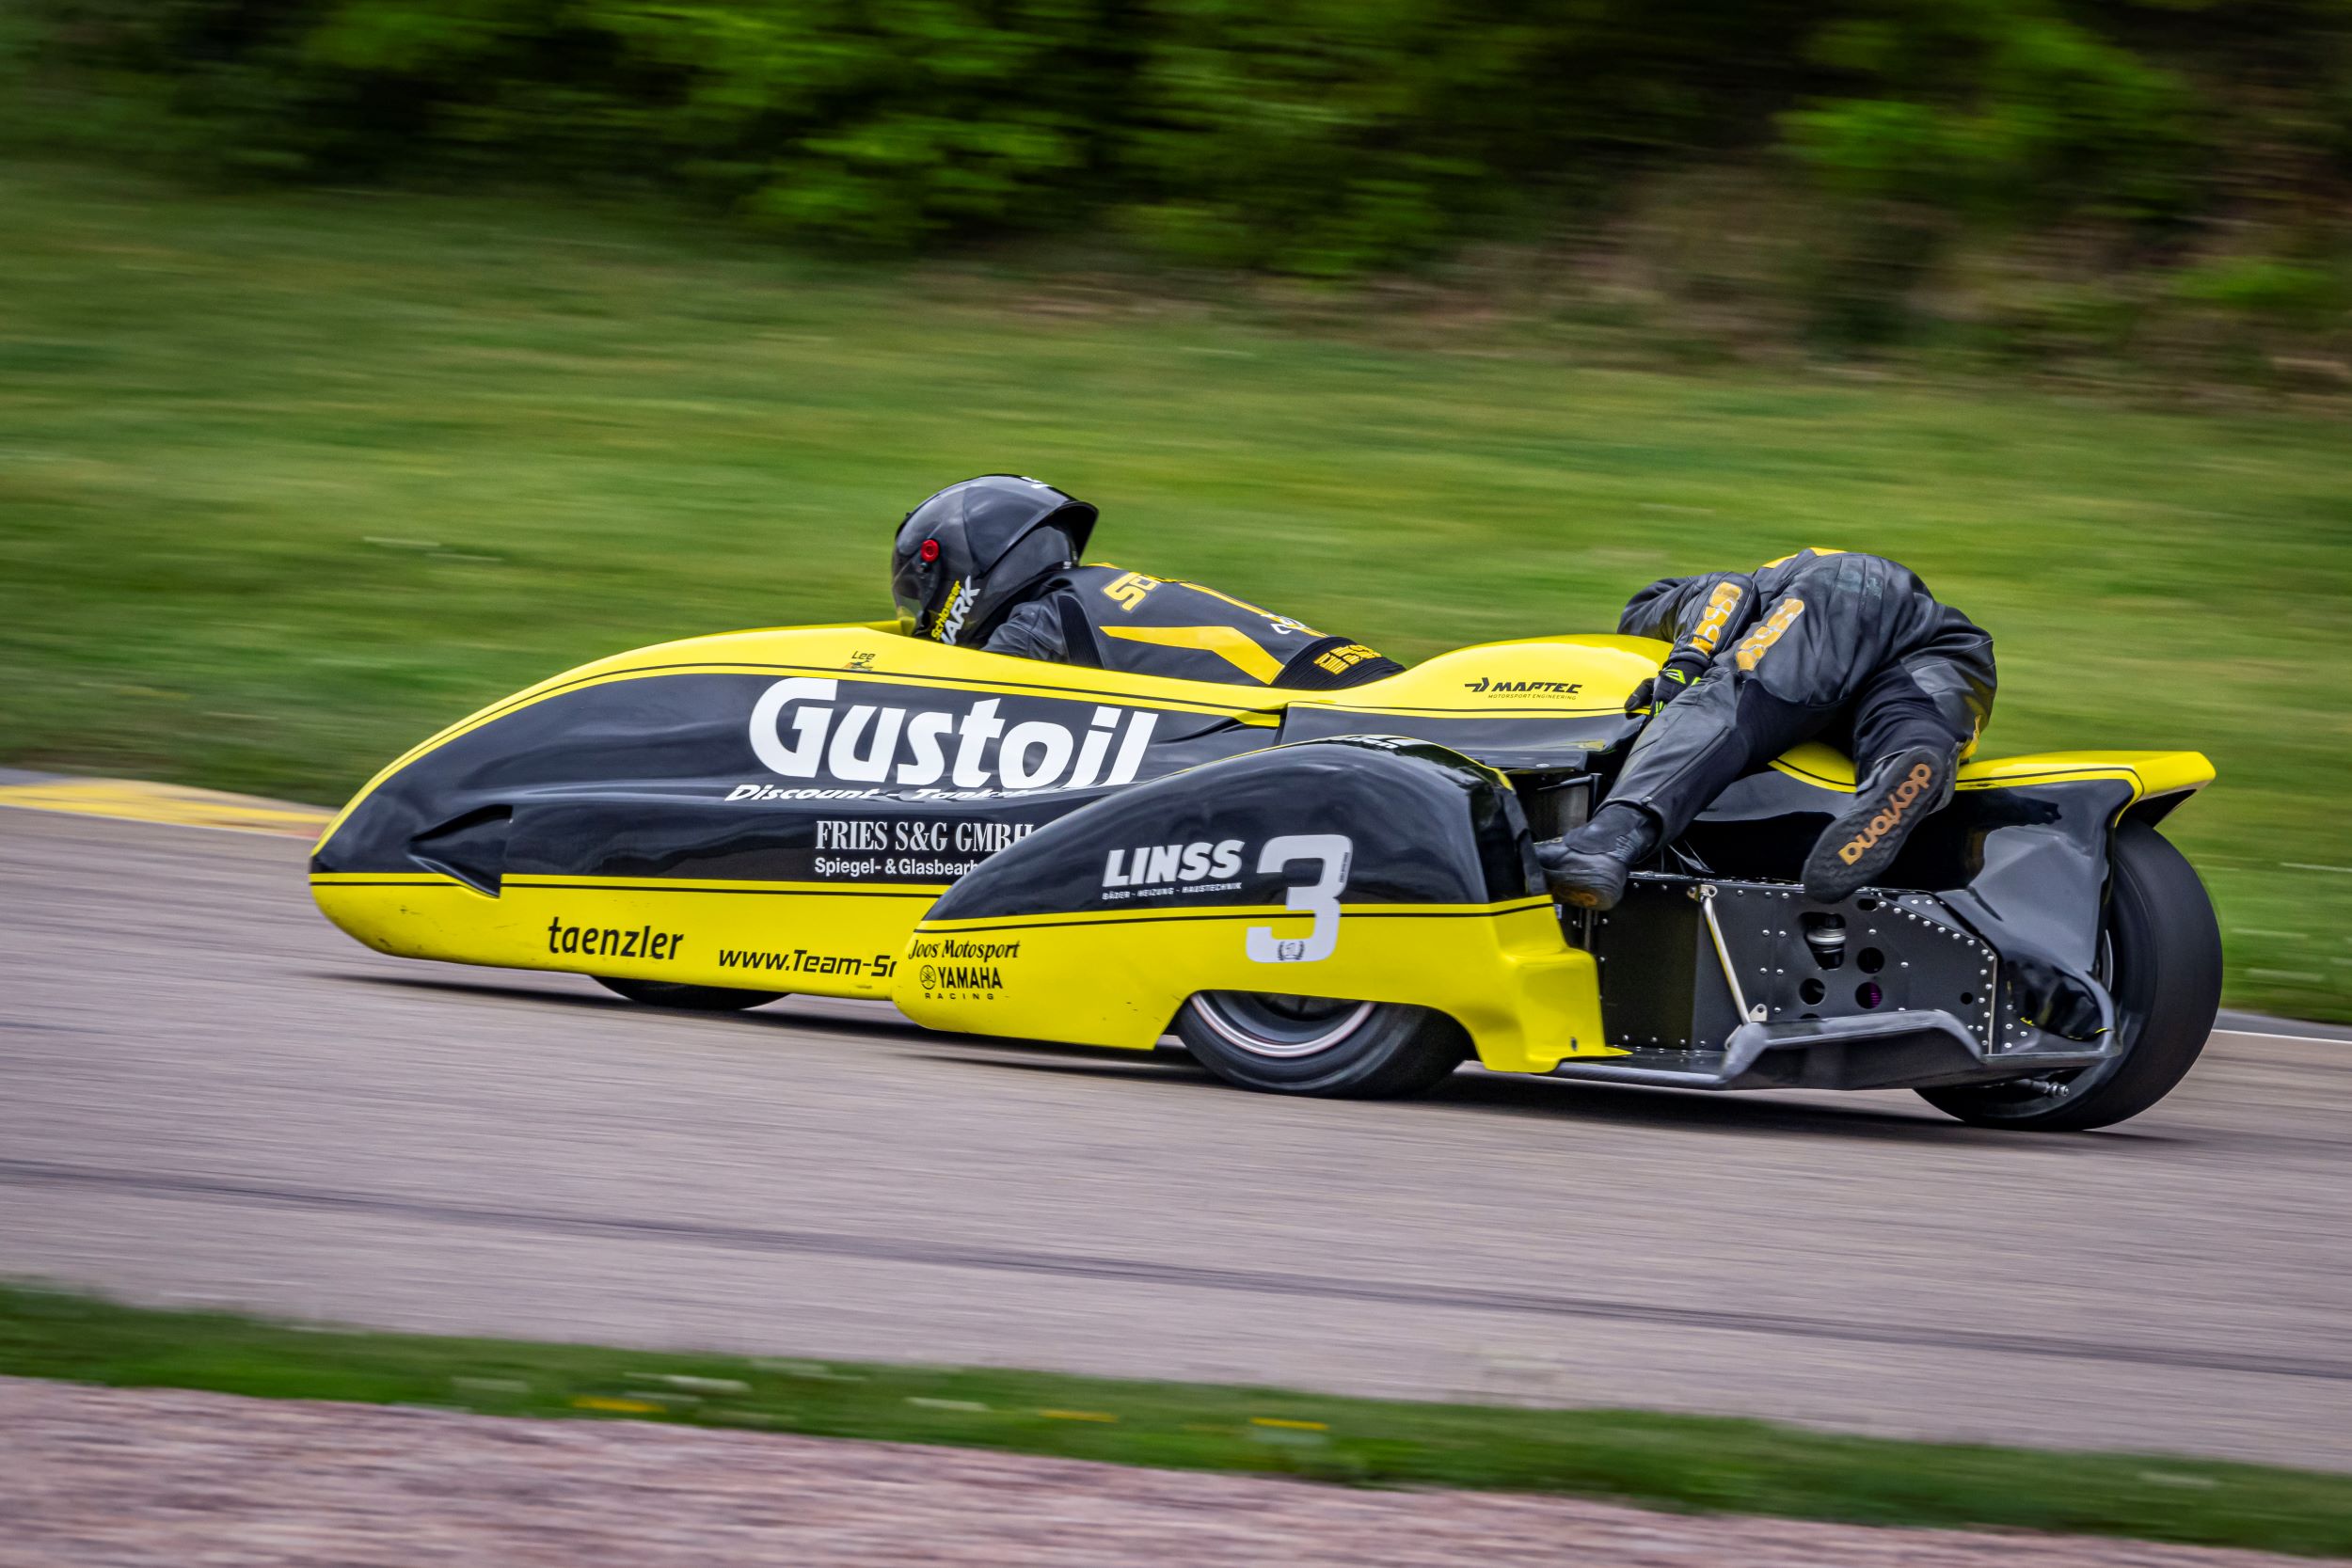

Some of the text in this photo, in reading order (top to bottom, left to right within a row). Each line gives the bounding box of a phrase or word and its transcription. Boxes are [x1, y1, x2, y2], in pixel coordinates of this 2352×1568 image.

[850, 650, 876, 660] Lee
[749, 676, 1158, 789] Gustoil
[724, 784, 881, 801] Discount
[1837, 763, 1931, 865] daytona
[815, 820, 888, 850] FRIES
[895, 821, 948, 851] S&G
[814, 857, 882, 877] Spiegel-
[884, 859, 898, 875] &
[1102, 839, 1246, 887] LINSS
[1182, 882, 1242, 893] HAUSTECHNIK
[1246, 834, 1353, 963] 3
[548, 916, 684, 960] taenzler
[908, 939, 1021, 963] Joos Motosport
[937, 967, 1003, 989] YAMAHA
